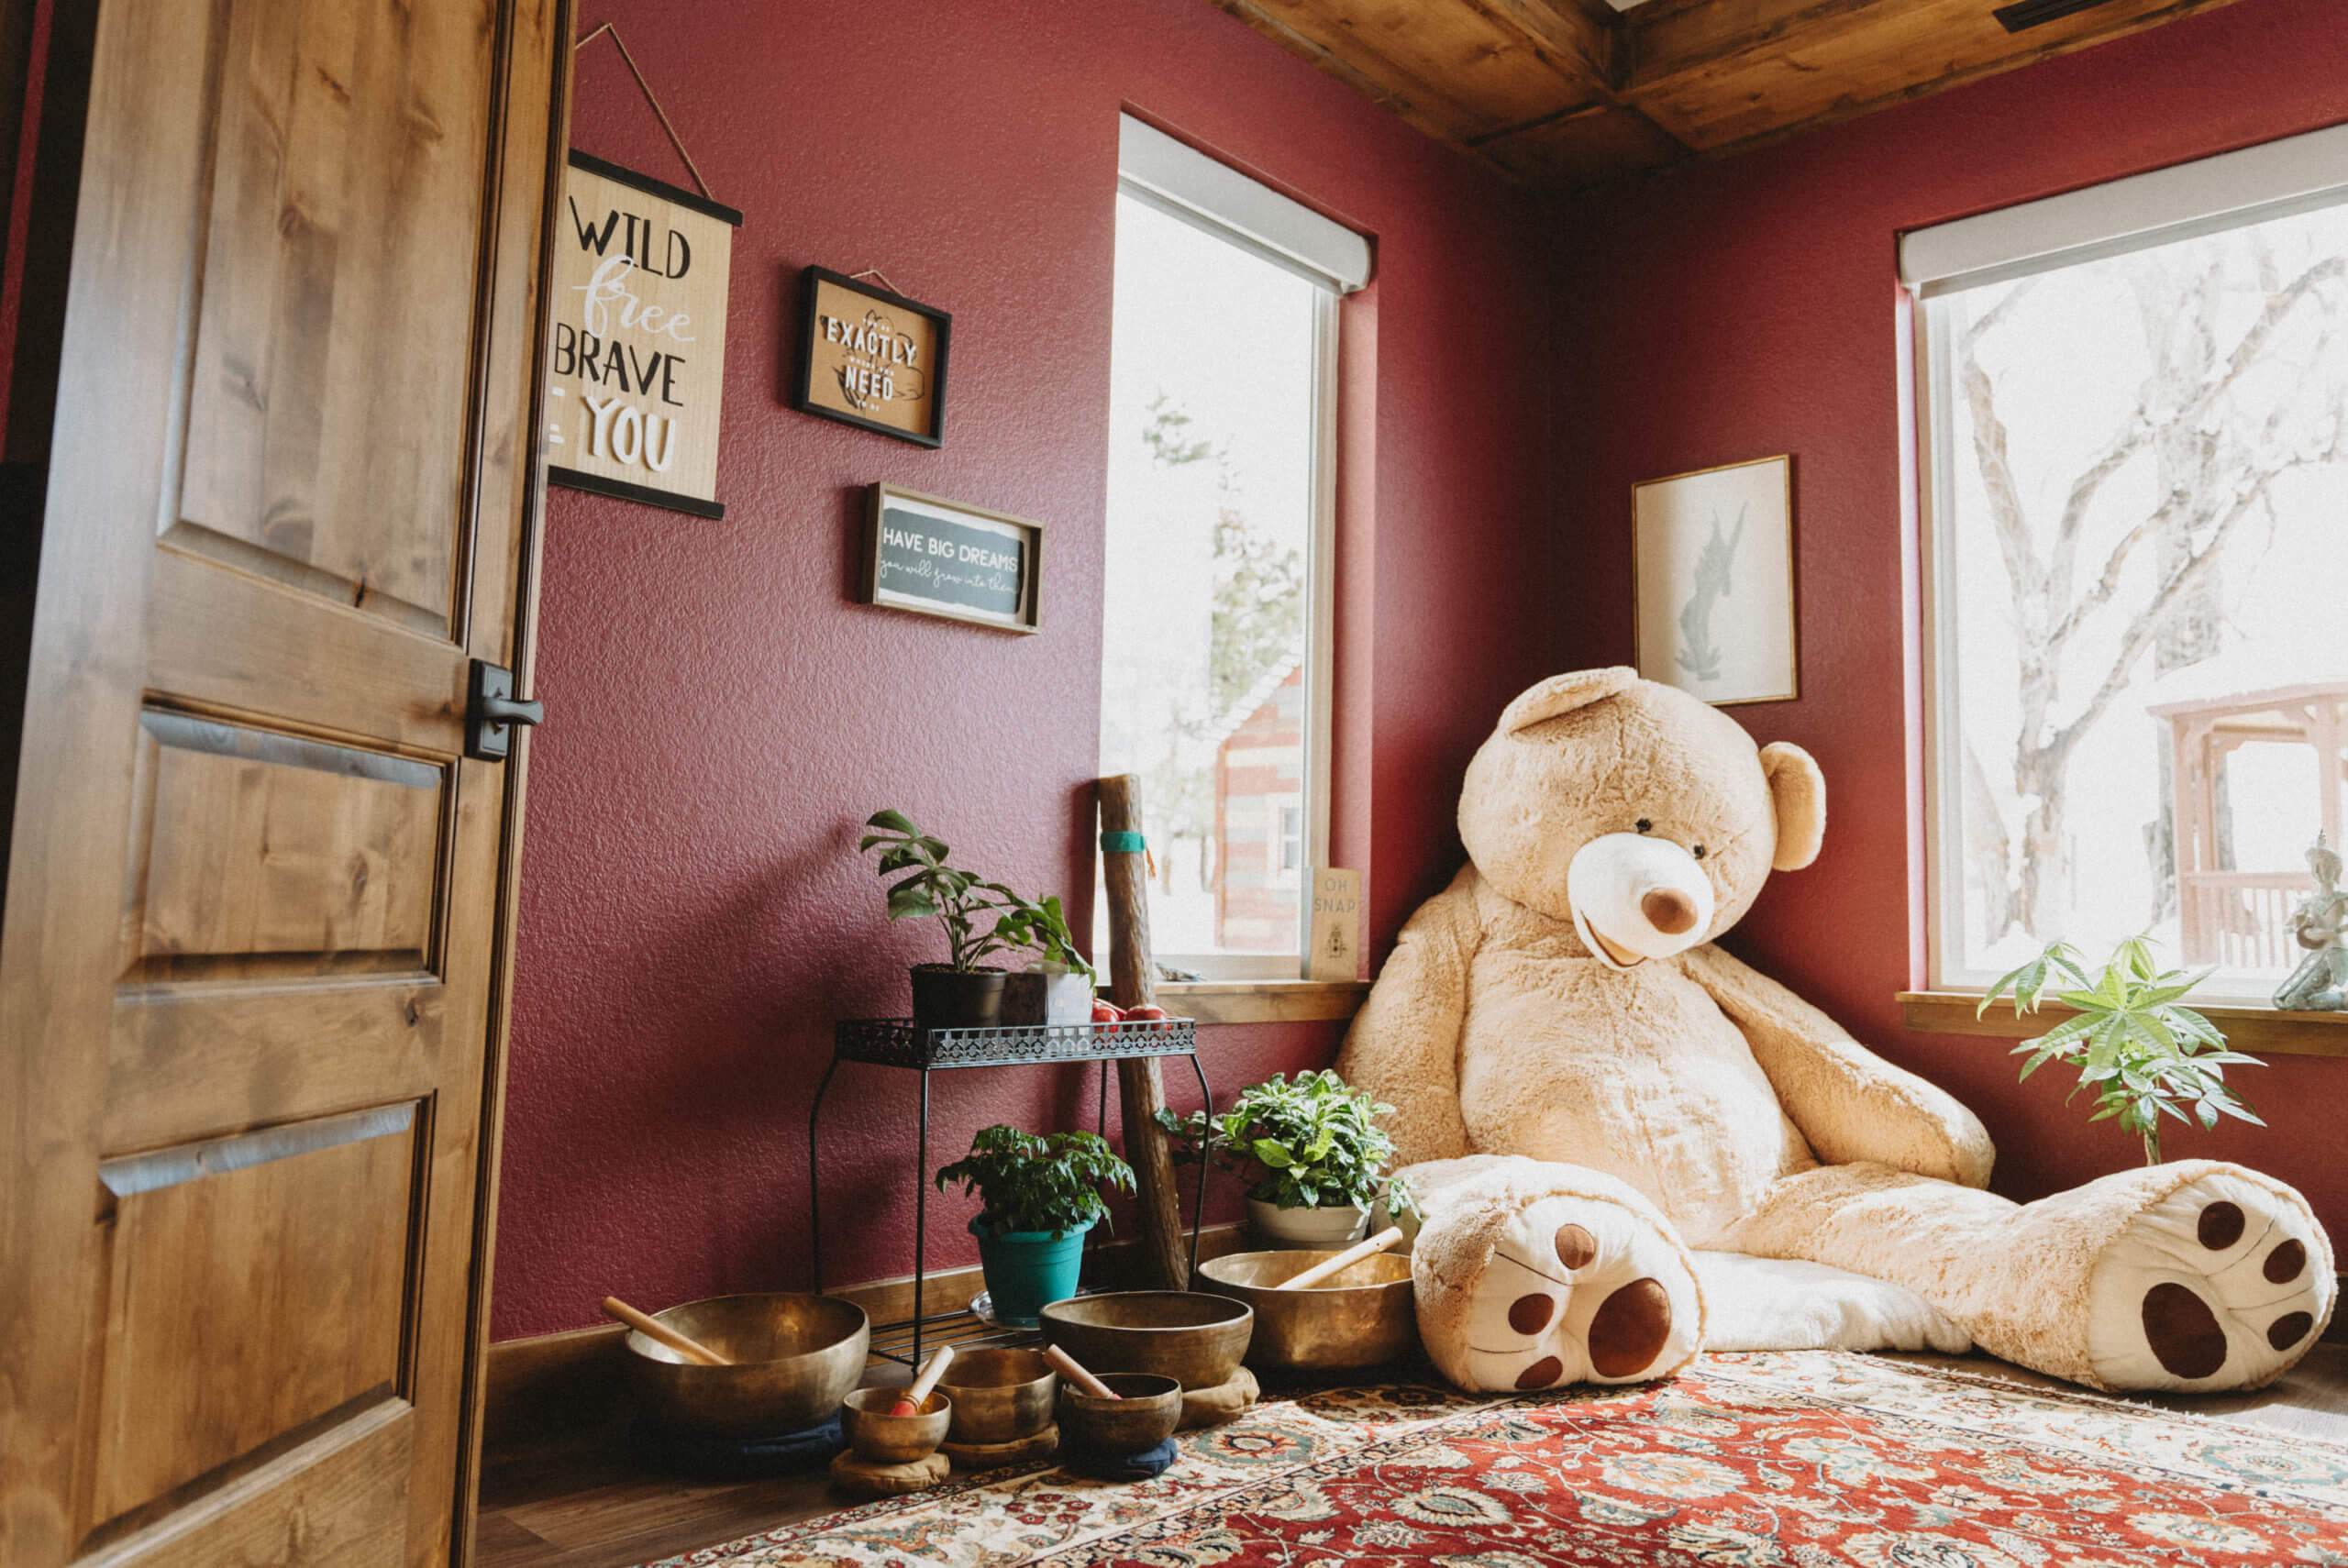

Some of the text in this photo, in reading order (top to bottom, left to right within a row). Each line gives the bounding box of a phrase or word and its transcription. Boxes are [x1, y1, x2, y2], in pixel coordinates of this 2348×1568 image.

[569, 195, 690, 279] WILD
[572, 255, 694, 342] free
[554, 323, 685, 406] BRAVE
[826, 317, 917, 367] EXACTLY
[845, 365, 893, 401] NEED
[584, 395, 676, 472] YOU
[880, 558, 903, 579] you
[904, 558, 932, 578] will
[933, 568, 963, 589] grow
[883, 527, 1018, 573] HAVE BIG DREAMS
[1313, 898, 1357, 913] SNAP
[1324, 878, 1351, 892] OH
